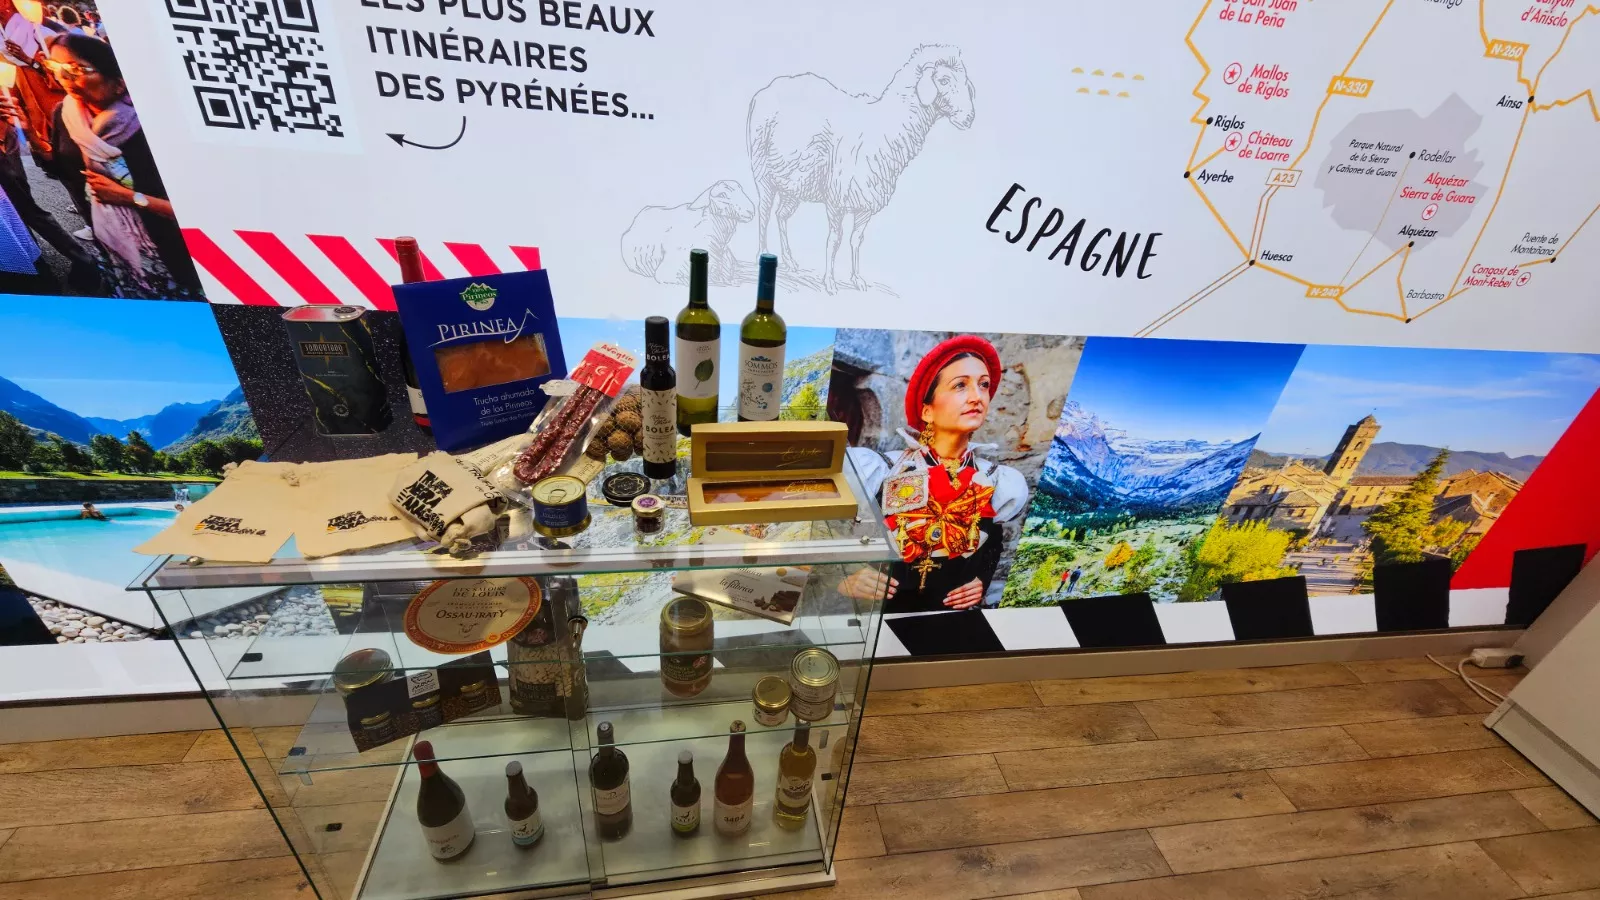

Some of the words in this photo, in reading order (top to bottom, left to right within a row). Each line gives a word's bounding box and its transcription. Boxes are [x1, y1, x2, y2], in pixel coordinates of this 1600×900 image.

[539, 0, 655, 37] BEAUX
[1219, 3, 1235, 21] de
[1238, 7, 1253, 23] La
[1254, 10, 1286, 28] Peña
[366, 26, 588, 73] ITINÉRAIRES
[1490, 44, 1522, 57] N-260
[1250, 63, 1290, 81] Mallos
[1238, 72, 1252, 93] de
[1255, 80, 1290, 100] Riglos
[1333, 82, 1368, 94] N-330
[375, 71, 445, 102] DES
[456, 77, 655, 120] PYRÉNÉES...
[1214, 115, 1246, 131] Riglos
[1248, 130, 1293, 148] Château
[1349, 138, 1374, 152] Parque
[1376, 141, 1404, 153] Natural
[1238, 143, 1252, 160] de
[1255, 147, 1290, 162] Loarre
[1350, 153, 1360, 162] de
[1361, 153, 1368, 162] la
[1369, 154, 1390, 164] Sierra
[1418, 149, 1456, 165] Rodellar
[1198, 169, 1234, 184] Ayerbe
[1272, 172, 1295, 184] A23
[1328, 166, 1334, 174] y
[1335, 163, 1365, 176] Cañones
[1366, 166, 1375, 176] de
[1376, 168, 1398, 178] Guara
[1424, 172, 1470, 188] Alquézar
[1400, 186, 1430, 202] Sierra
[1431, 187, 1444, 202] de
[1446, 190, 1476, 204] Guara
[986, 183, 1163, 279] ESPAGNE
[1398, 224, 1439, 239] Alquézar
[1522, 232, 1548, 244] Puente
[1549, 233, 1559, 244] de
[1261, 250, 1294, 263] Huesca
[1471, 263, 1506, 277] Congost
[1507, 265, 1519, 277] de
[1310, 287, 1340, 297] N-240
[1406, 289, 1446, 301] Barbastro
[437, 317, 519, 341] PIRINEA
[473, 394, 499, 406] Trucha
[500, 387, 535, 401] ahumada
[481, 406, 491, 416] de
[492, 404, 504, 413] los
[645, 425, 674, 434] BOLEA
